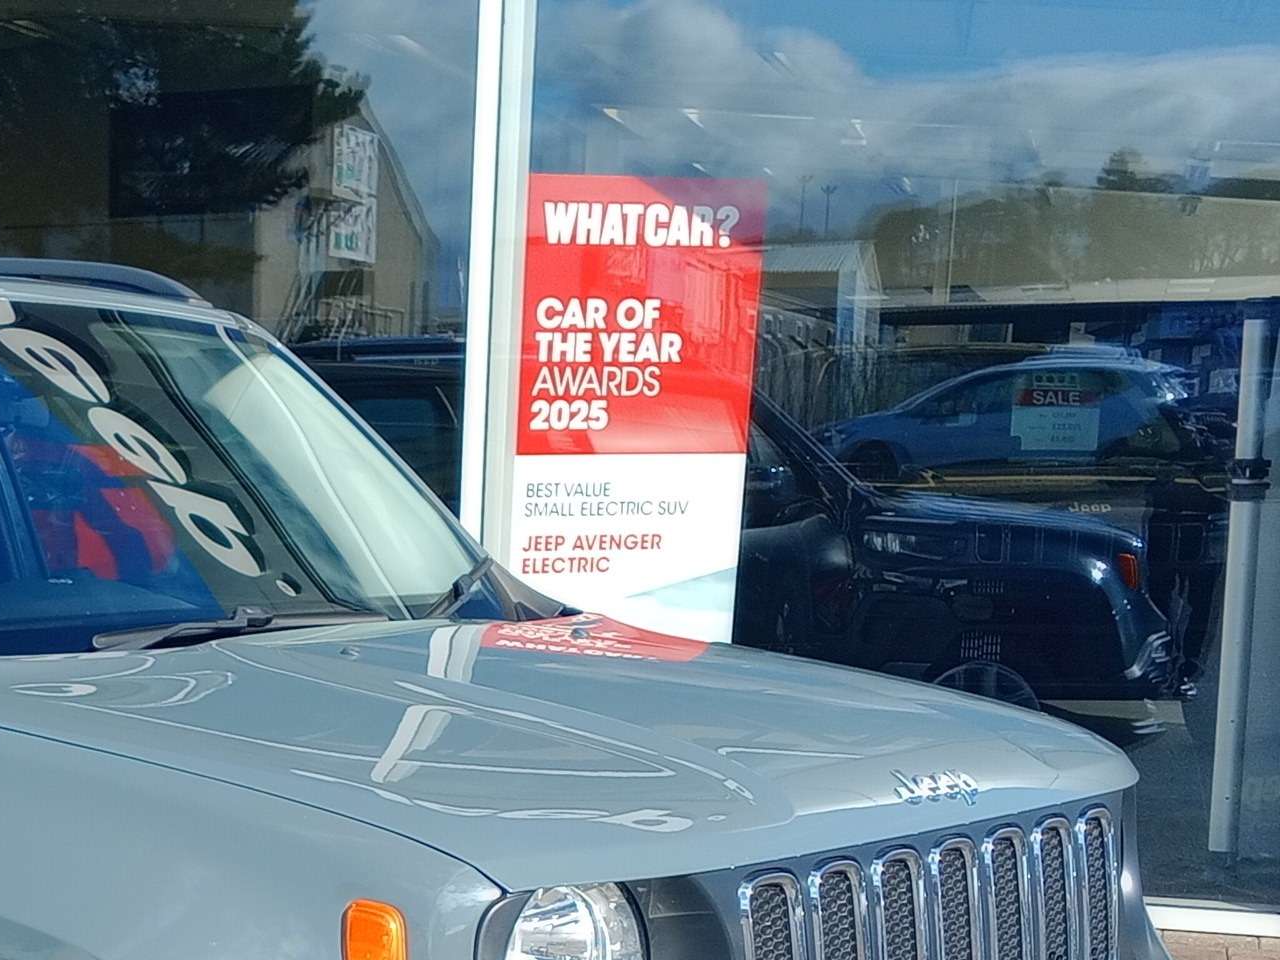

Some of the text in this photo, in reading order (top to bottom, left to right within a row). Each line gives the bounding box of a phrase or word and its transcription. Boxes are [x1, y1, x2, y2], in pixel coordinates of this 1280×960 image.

[536, 297, 662, 330] CAR OF
[535, 332, 683, 363] THE YEAR
[531, 365, 661, 397] AWARDS
[1032, 391, 1081, 405] SALE
[529, 399, 609, 431] 2025
[526, 482, 612, 498] BEST VALUE
[524, 500, 689, 518] SMALL ELECTRIC SUV
[522, 533, 663, 552] JEEP AVENGER
[521, 556, 610, 575] ELECTRIC
[889, 769, 979, 806] Jeep
